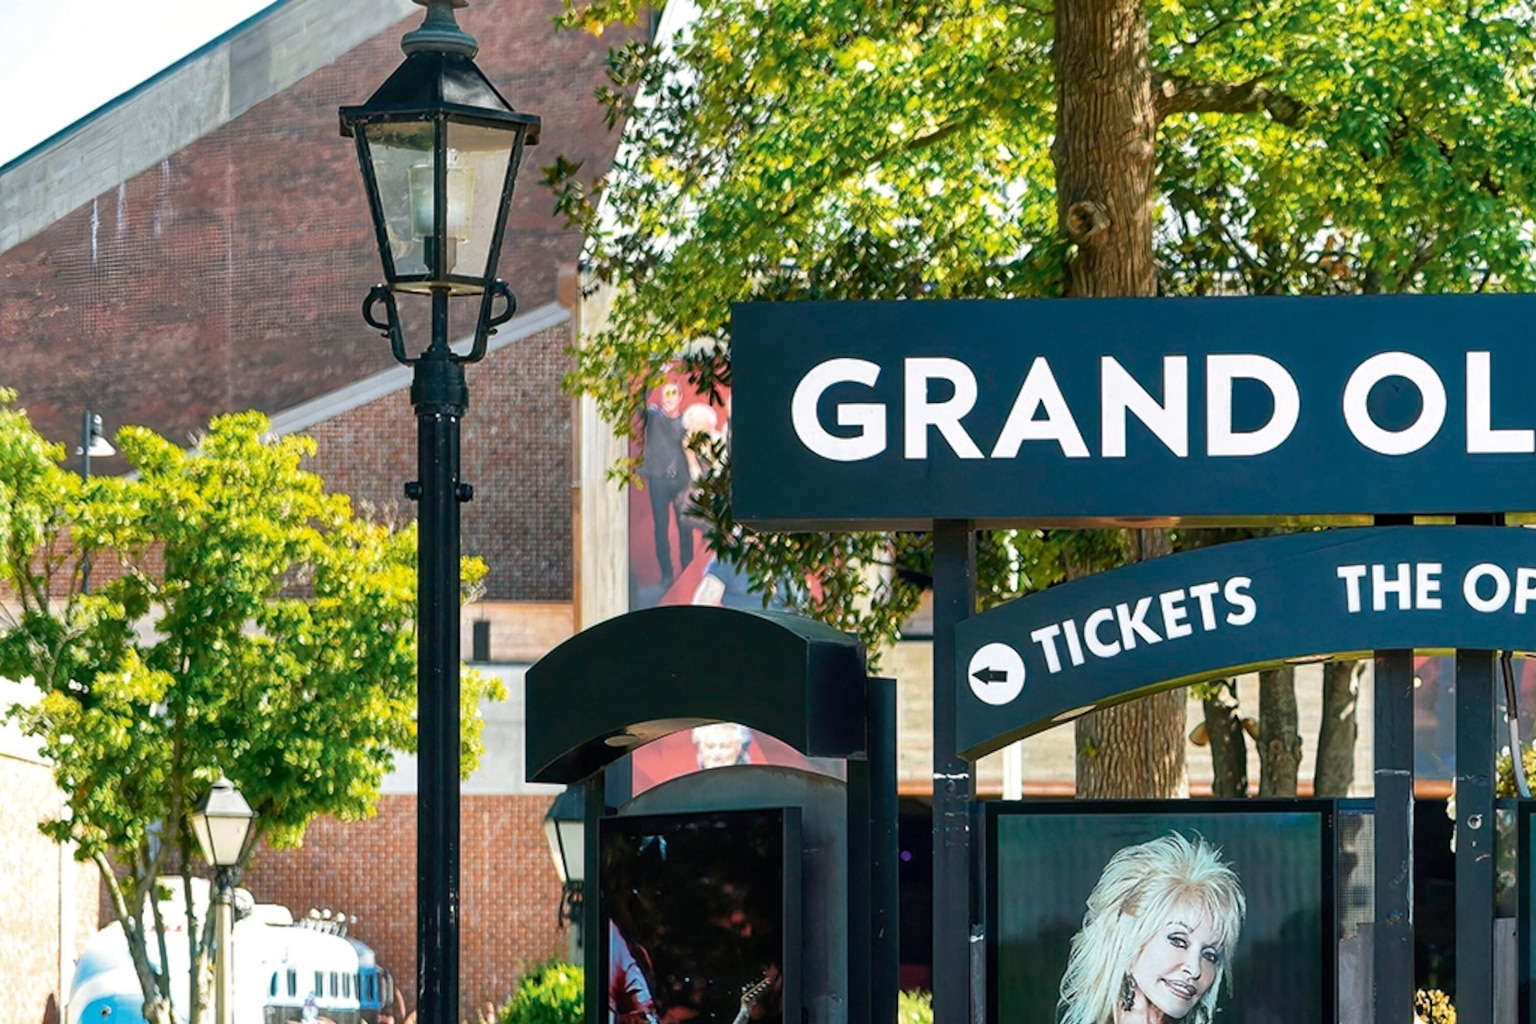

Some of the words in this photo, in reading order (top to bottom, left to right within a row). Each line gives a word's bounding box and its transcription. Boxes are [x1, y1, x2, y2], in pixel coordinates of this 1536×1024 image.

[792, 355, 1299, 461] GRAND
[1030, 575, 1258, 675] TICKETS
[1338, 564, 1441, 612] THE
